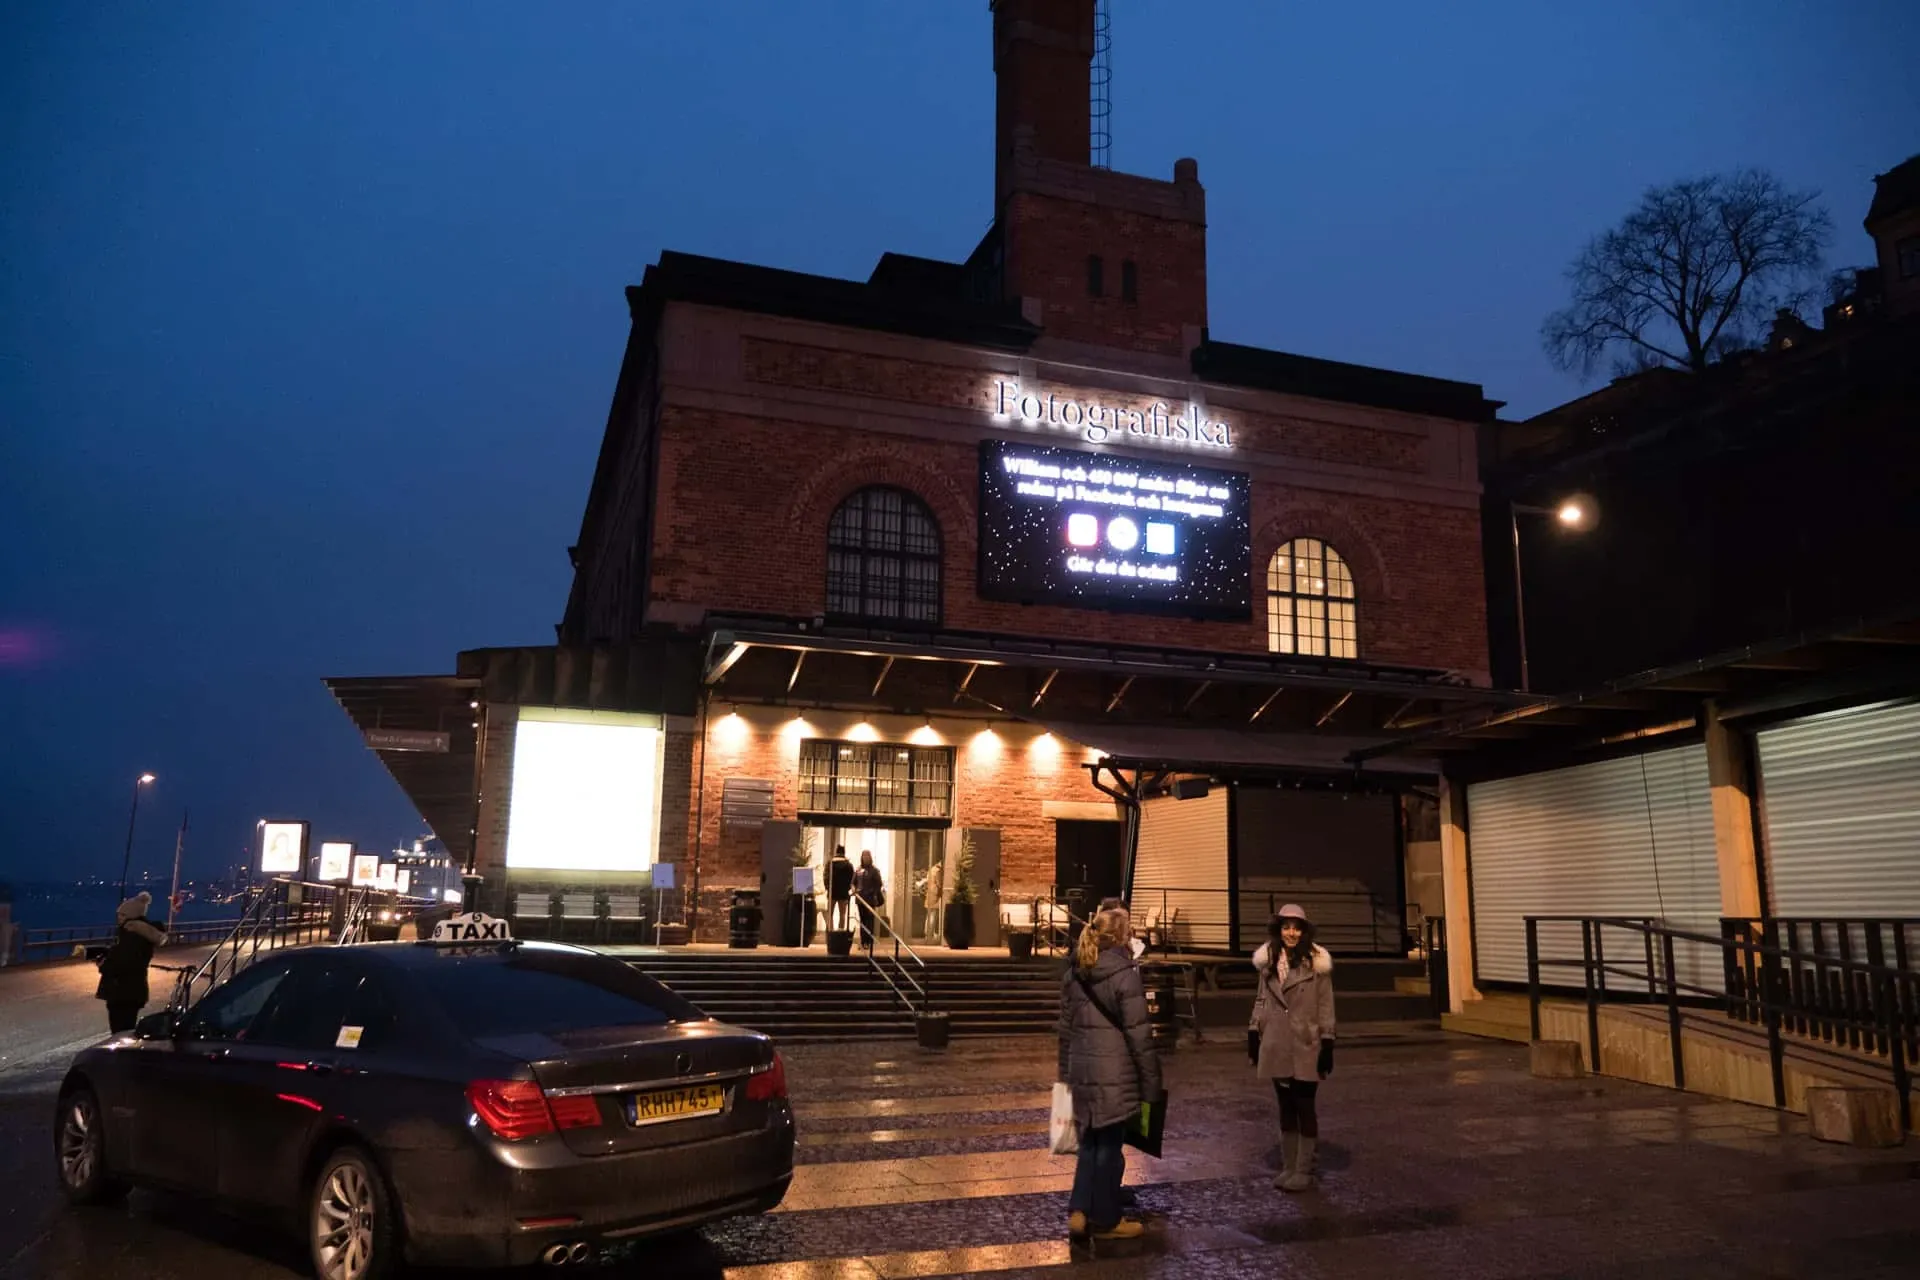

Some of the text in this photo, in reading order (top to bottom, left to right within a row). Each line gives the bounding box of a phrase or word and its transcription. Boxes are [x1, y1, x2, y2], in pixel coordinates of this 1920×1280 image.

[993, 379, 1233, 448] Fotografiska
[1075, 486, 1136, 507] Facebook
[1136, 494, 1161, 509] och
[1162, 496, 1223, 517] Instagram
[446, 923, 506, 940] TAXI
[639, 1087, 709, 1116] RHH745
